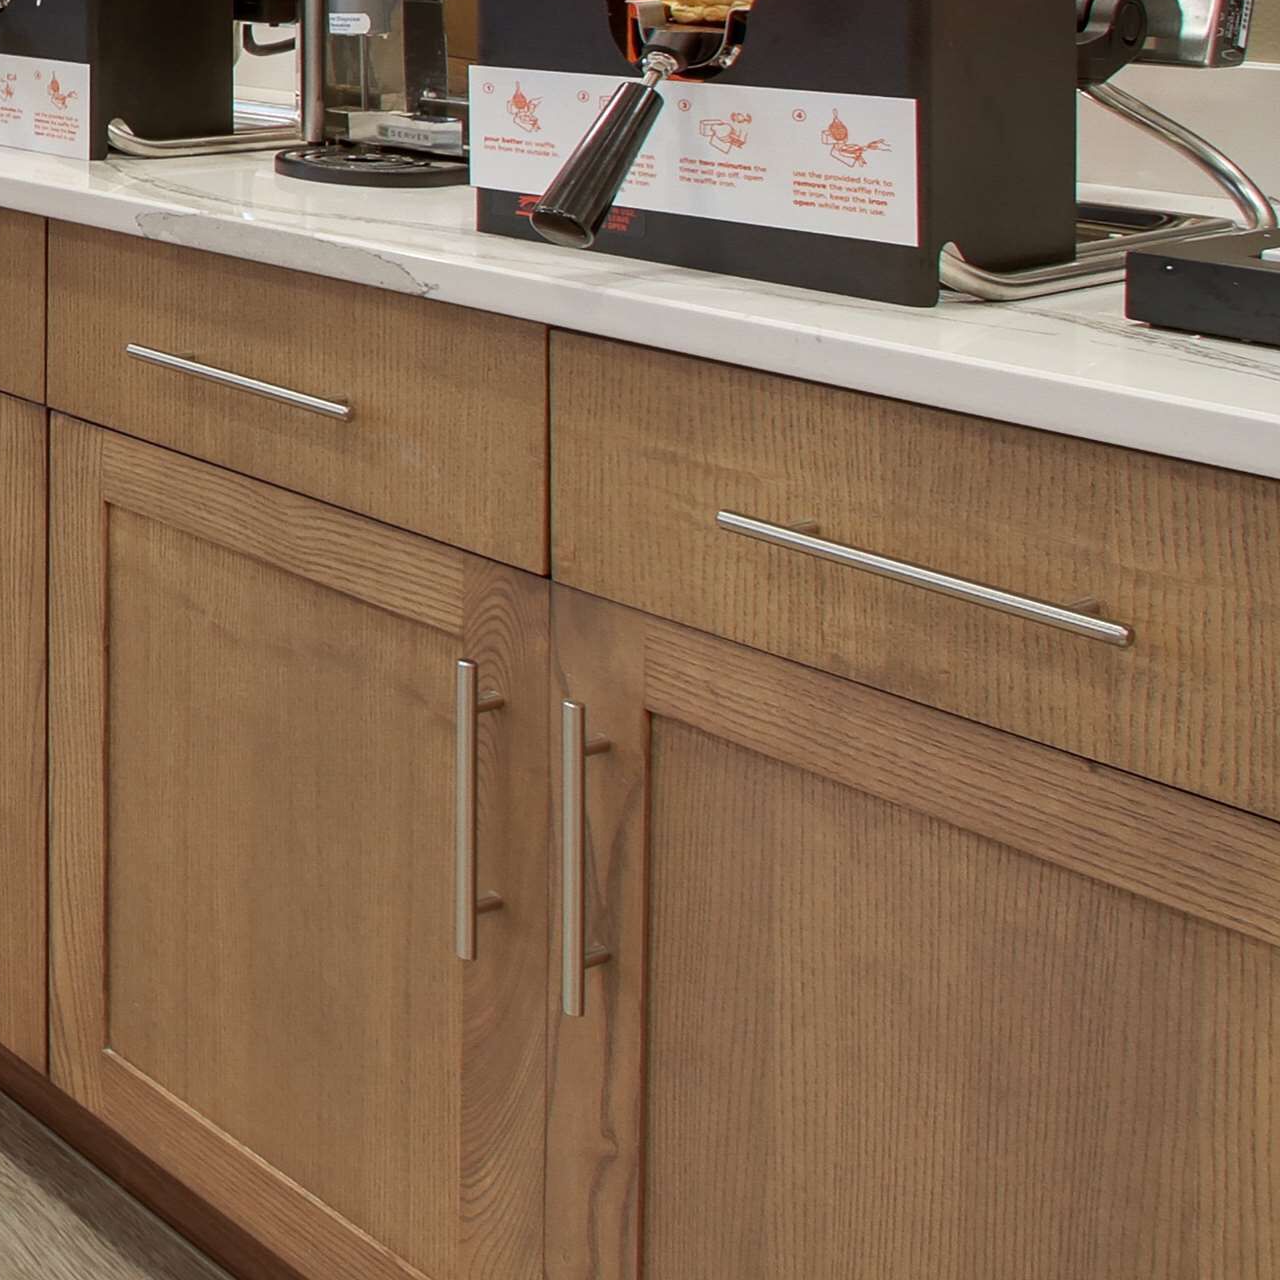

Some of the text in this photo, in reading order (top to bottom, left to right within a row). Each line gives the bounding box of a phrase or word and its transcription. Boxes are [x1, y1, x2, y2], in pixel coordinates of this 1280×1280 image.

[390, 129, 429, 141] SERVER
[717, 162, 752, 171] minutes
[808, 171, 822, 179] the
[824, 174, 861, 183] provided
[863, 177, 880, 186] fork
[793, 181, 896, 197] remove the waffle from
[792, 199, 816, 208] open
[818, 202, 840, 210] while
[830, 193, 850, 202] keep
[868, 198, 888, 206] iron
